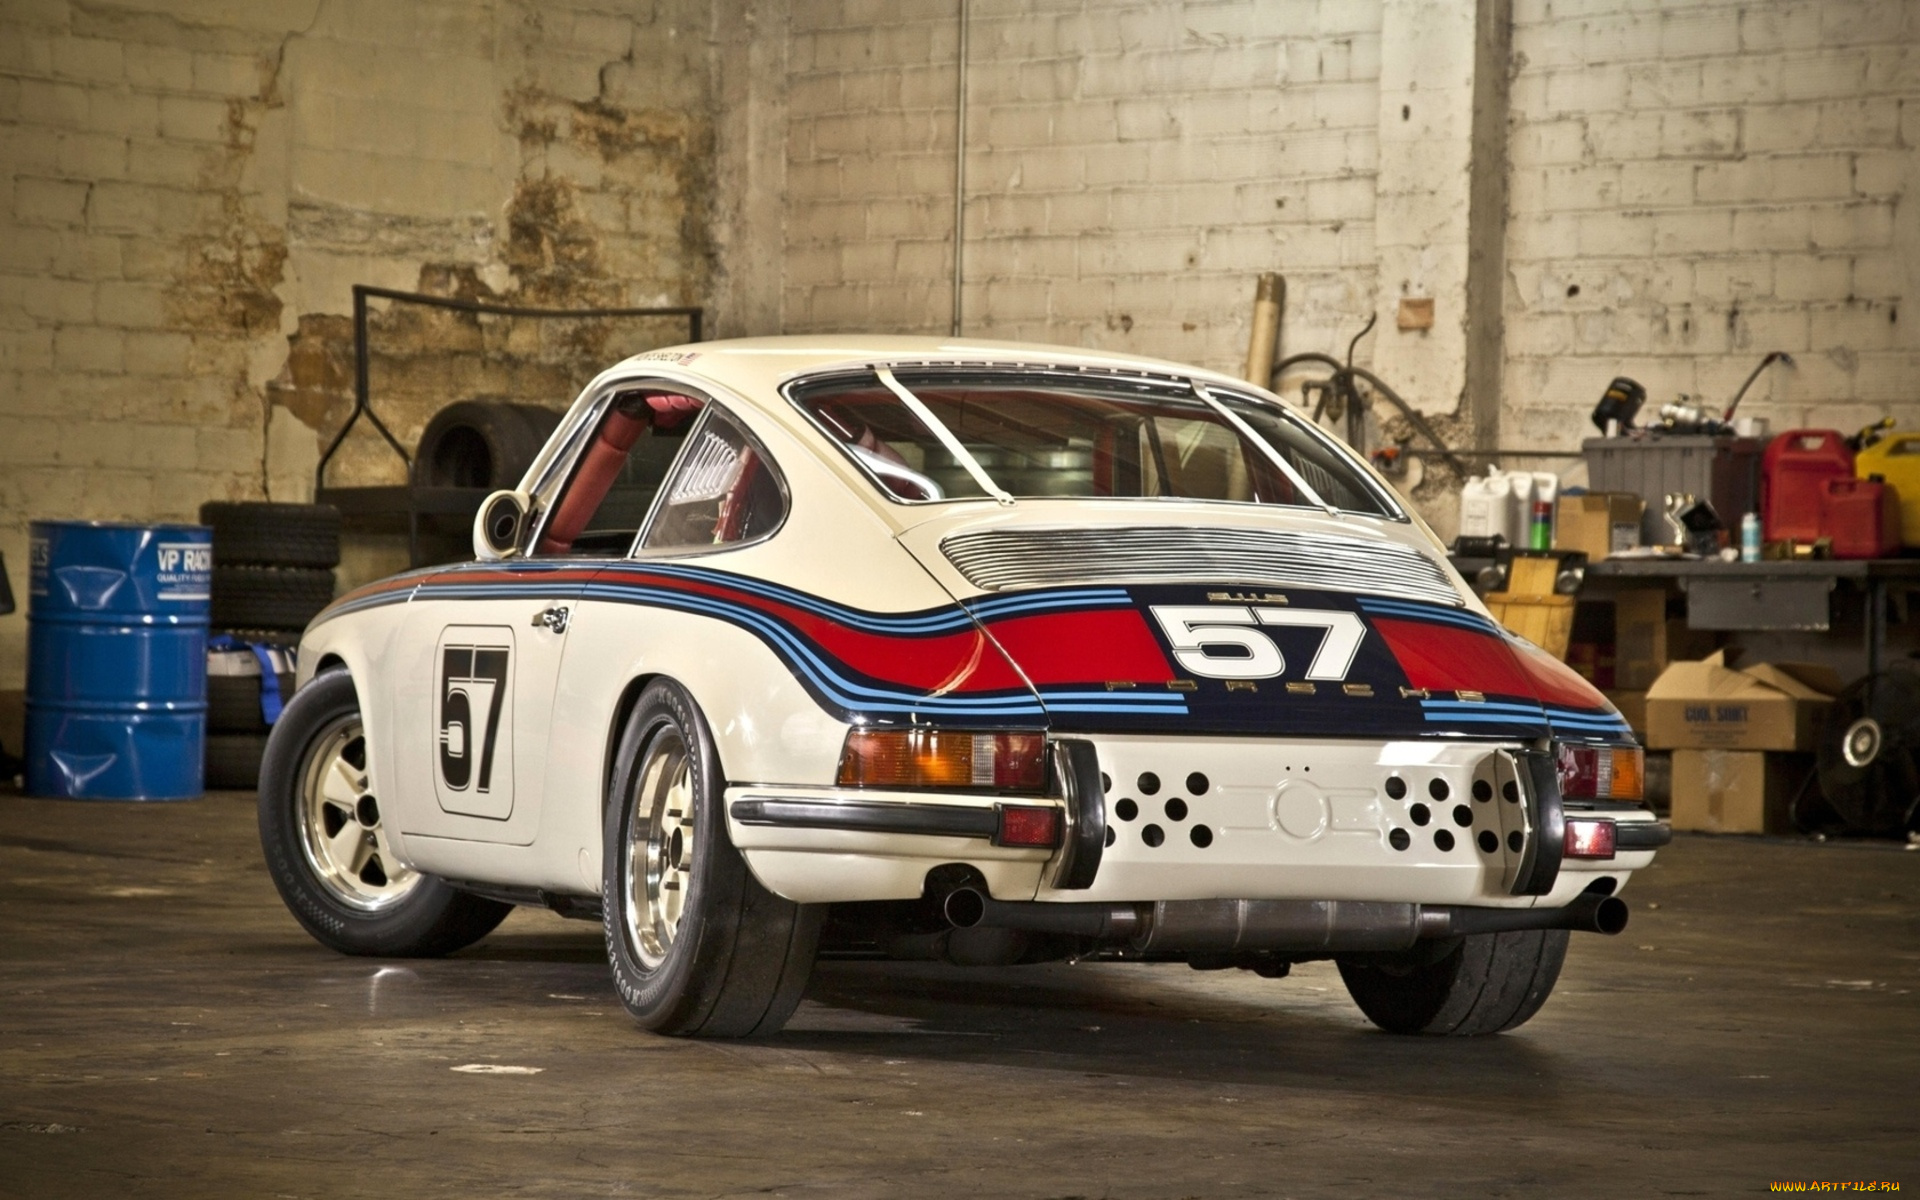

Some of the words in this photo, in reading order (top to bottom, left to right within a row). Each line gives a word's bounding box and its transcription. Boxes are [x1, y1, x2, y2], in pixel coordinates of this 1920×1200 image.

[157, 550, 180, 571] VP
[1149, 604, 1367, 682] 57
[1104, 679, 1486, 703] PORSCHE
[438, 643, 511, 794] 57
